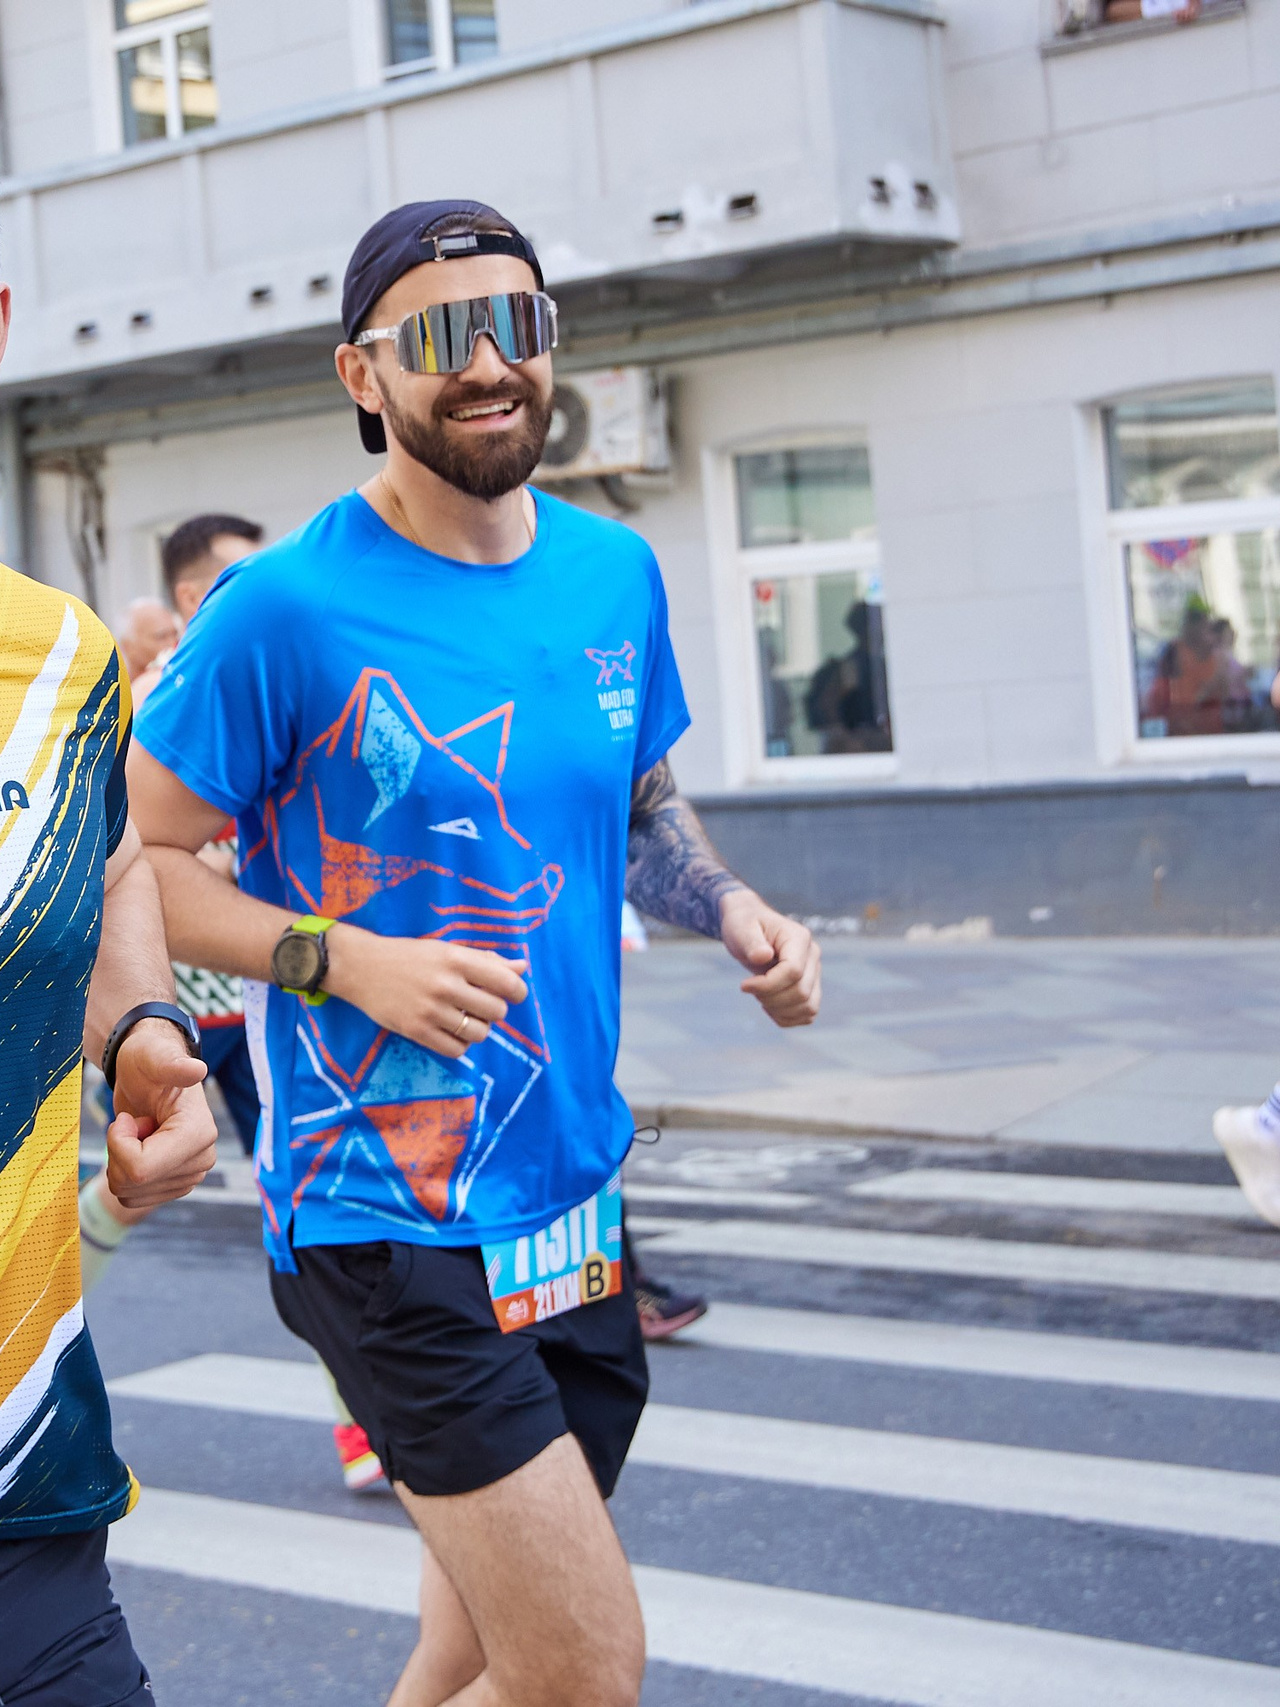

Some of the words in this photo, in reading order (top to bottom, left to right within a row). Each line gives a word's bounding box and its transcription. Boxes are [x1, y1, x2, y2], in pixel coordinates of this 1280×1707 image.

[598, 690, 621, 711] MAD
[609, 709, 634, 730] ULTRA
[586, 1261, 604, 1298] B
